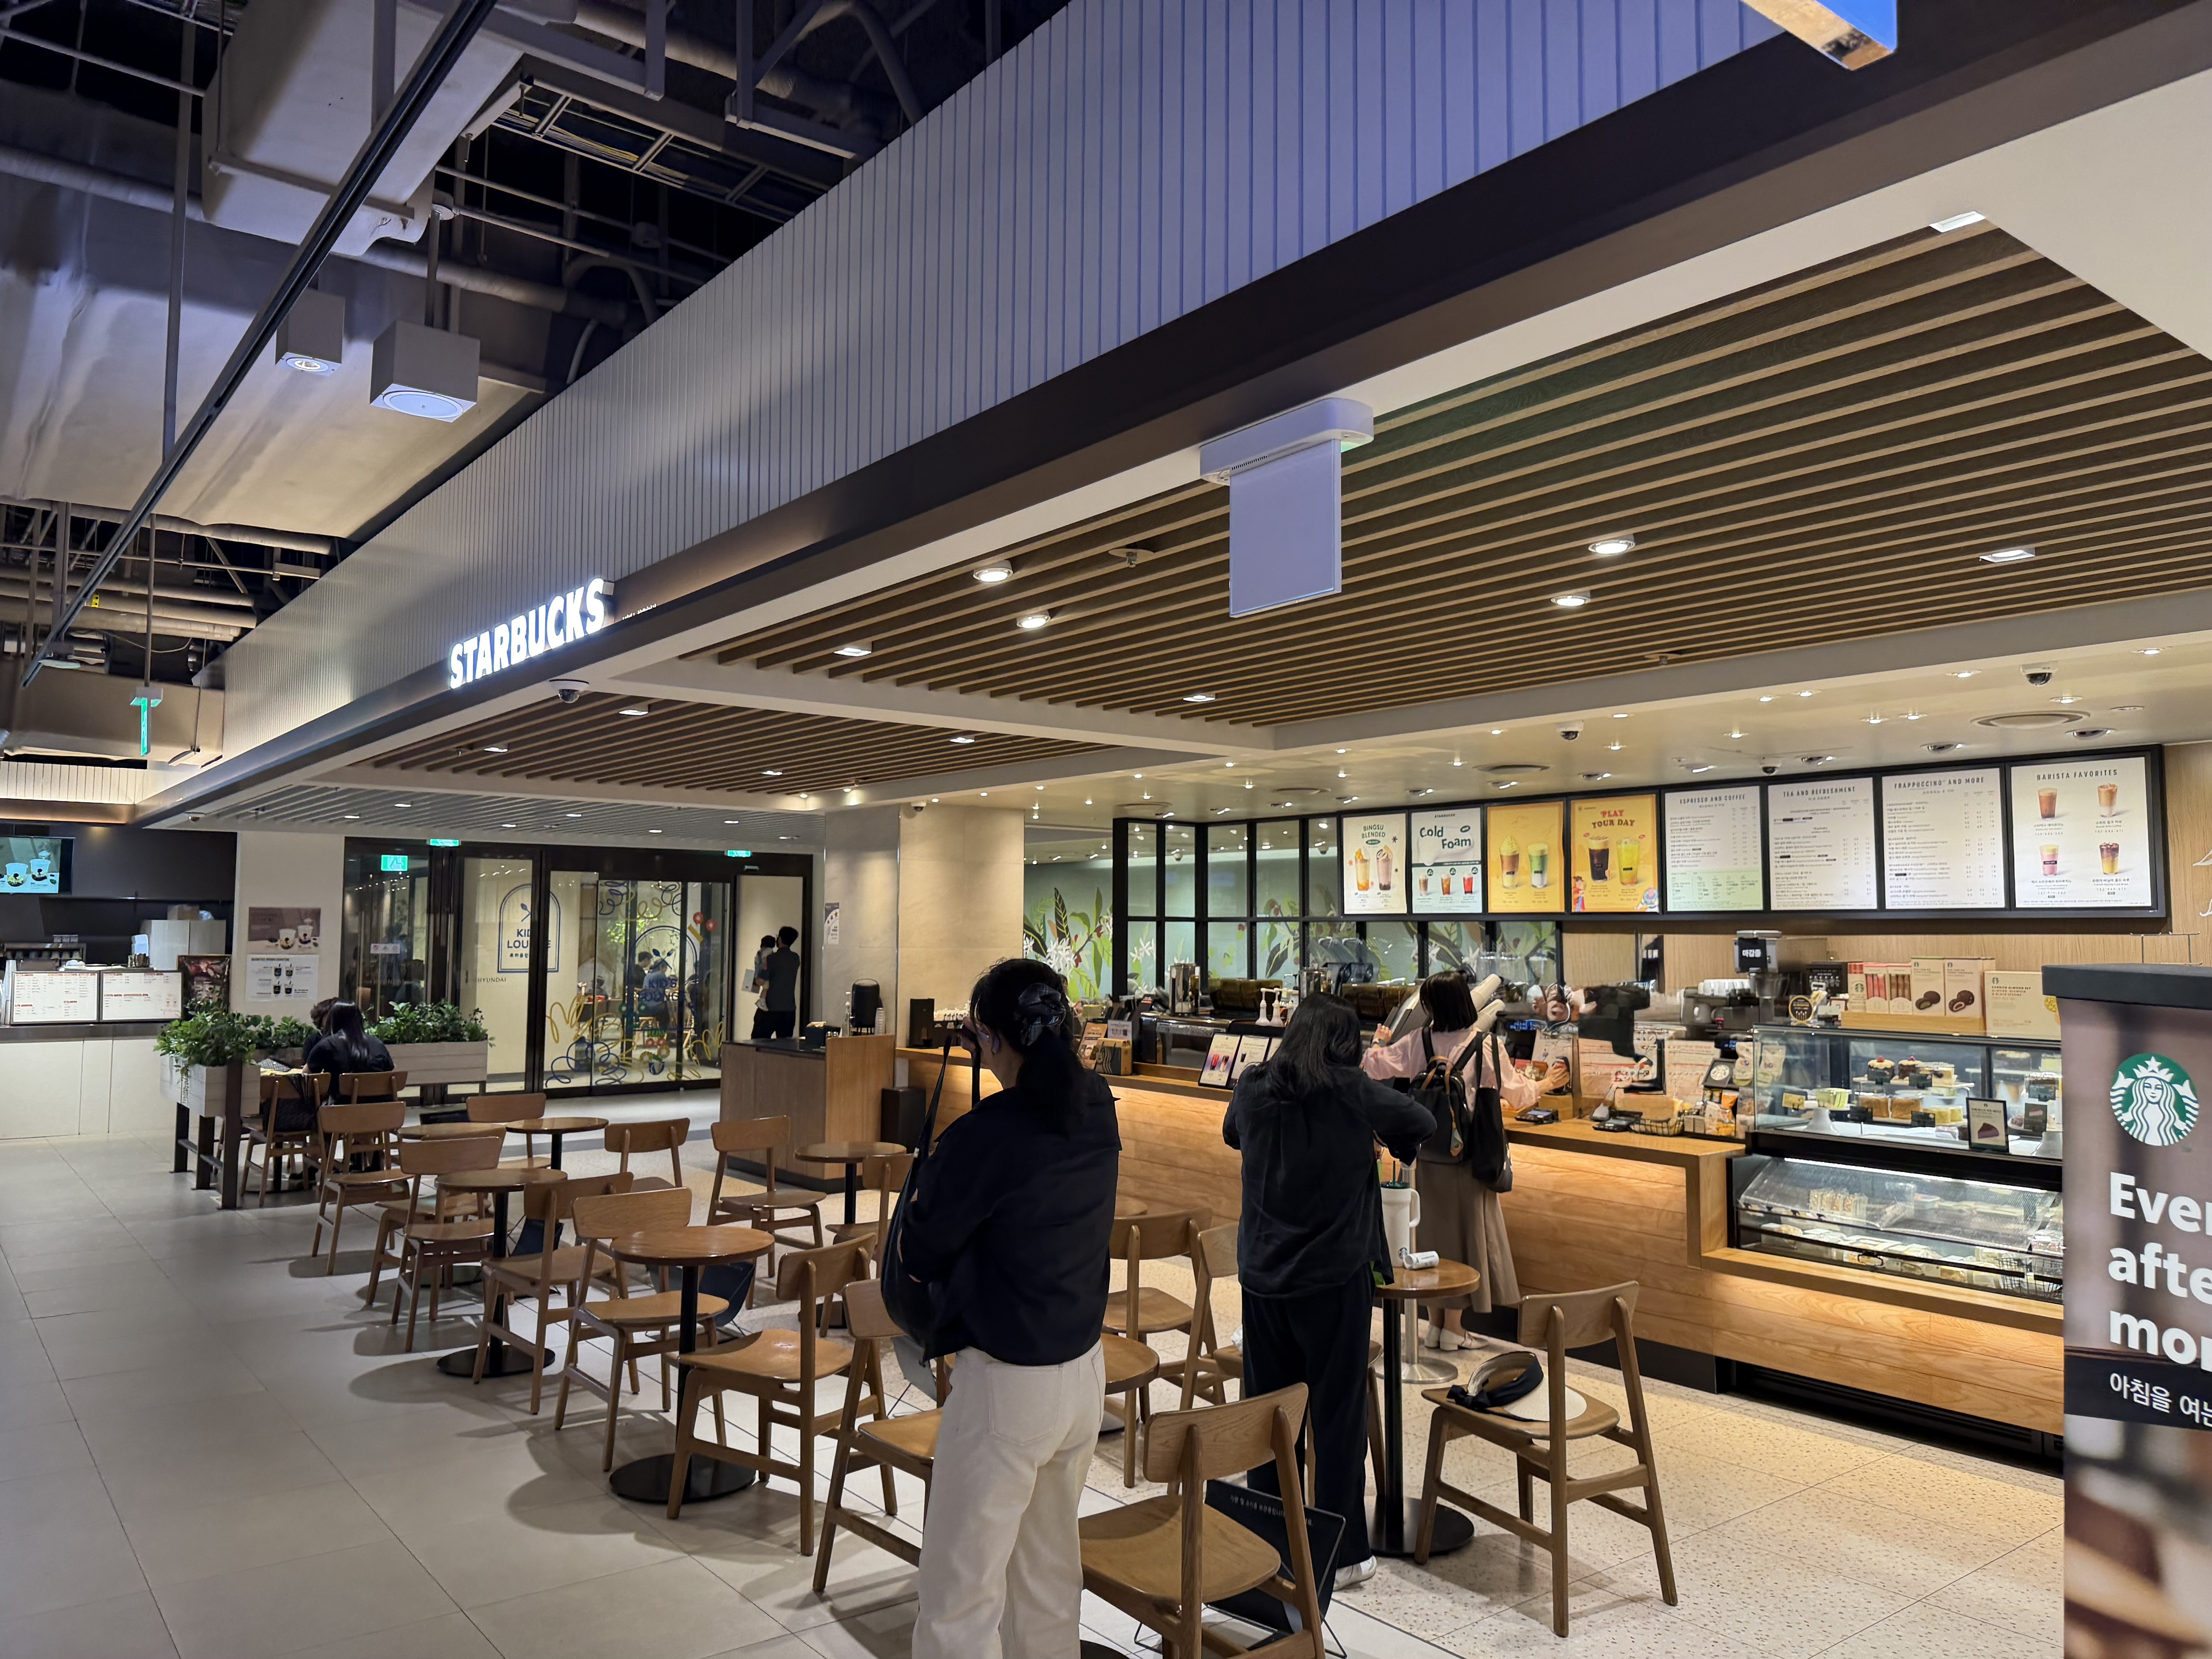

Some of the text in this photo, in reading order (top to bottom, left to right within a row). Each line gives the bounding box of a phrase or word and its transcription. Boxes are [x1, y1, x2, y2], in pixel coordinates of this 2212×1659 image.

[450, 578, 604, 689] STARBUCKS
[2037, 769, 2118, 781] BARISTA FAVORITES
[1811, 786, 1855, 795] REFRESHMENT
[1600, 809, 1624, 818] PLAY
[1592, 819, 1636, 828] YOUR DAY
[1420, 825, 1444, 838] Cold
[1441, 837, 1471, 849] Foam
[2110, 1171, 2212, 1236] Eve
[2110, 1373, 2172, 1414] 아침을
